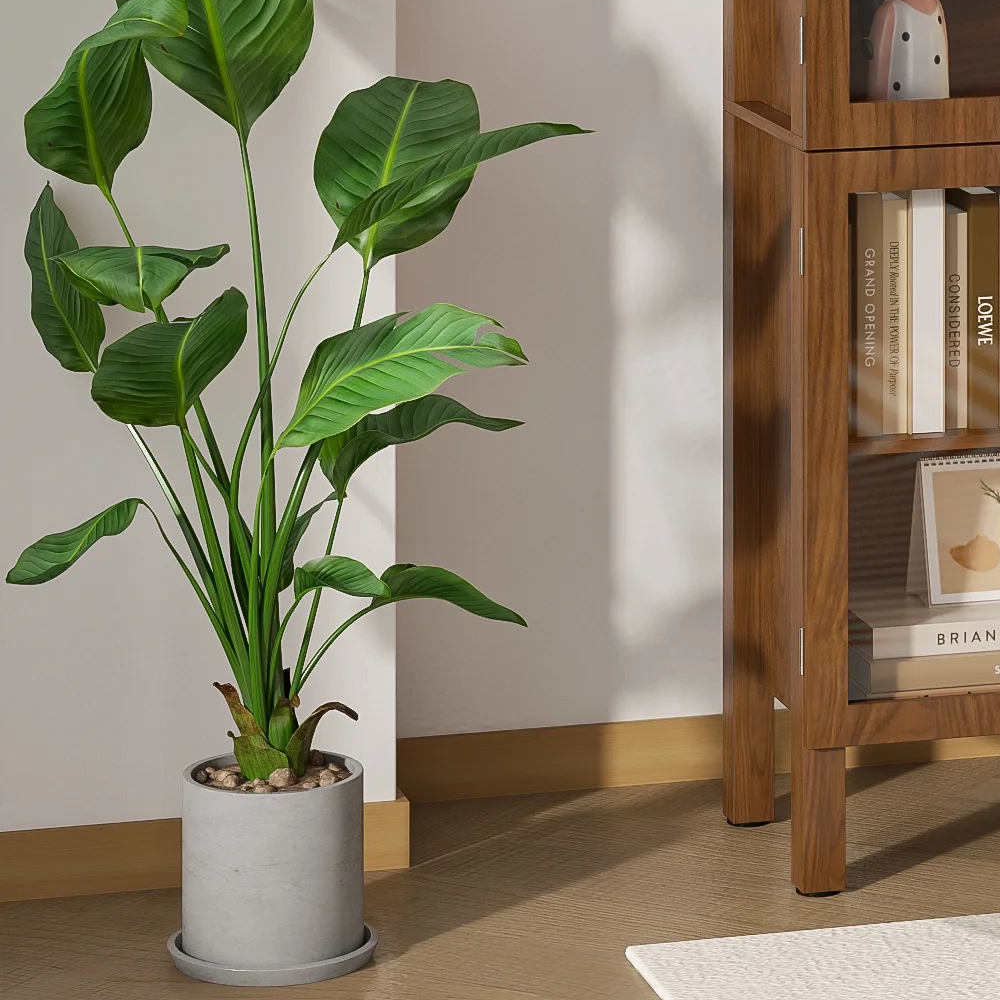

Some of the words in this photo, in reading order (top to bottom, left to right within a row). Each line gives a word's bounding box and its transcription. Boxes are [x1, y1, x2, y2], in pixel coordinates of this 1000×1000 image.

[890, 241, 899, 270] DEEPLY
[865, 248, 876, 297] GRAND
[890, 272, 899, 296] Rooted
[890, 298, 899, 306] IN
[890, 308, 899, 323] THE
[948, 274, 960, 368] CONSIDERED
[977, 296, 993, 346] LOEWE
[865, 304, 876, 367] OPENING
[890, 326, 899, 354] POWER
[890, 356, 899, 367] OF
